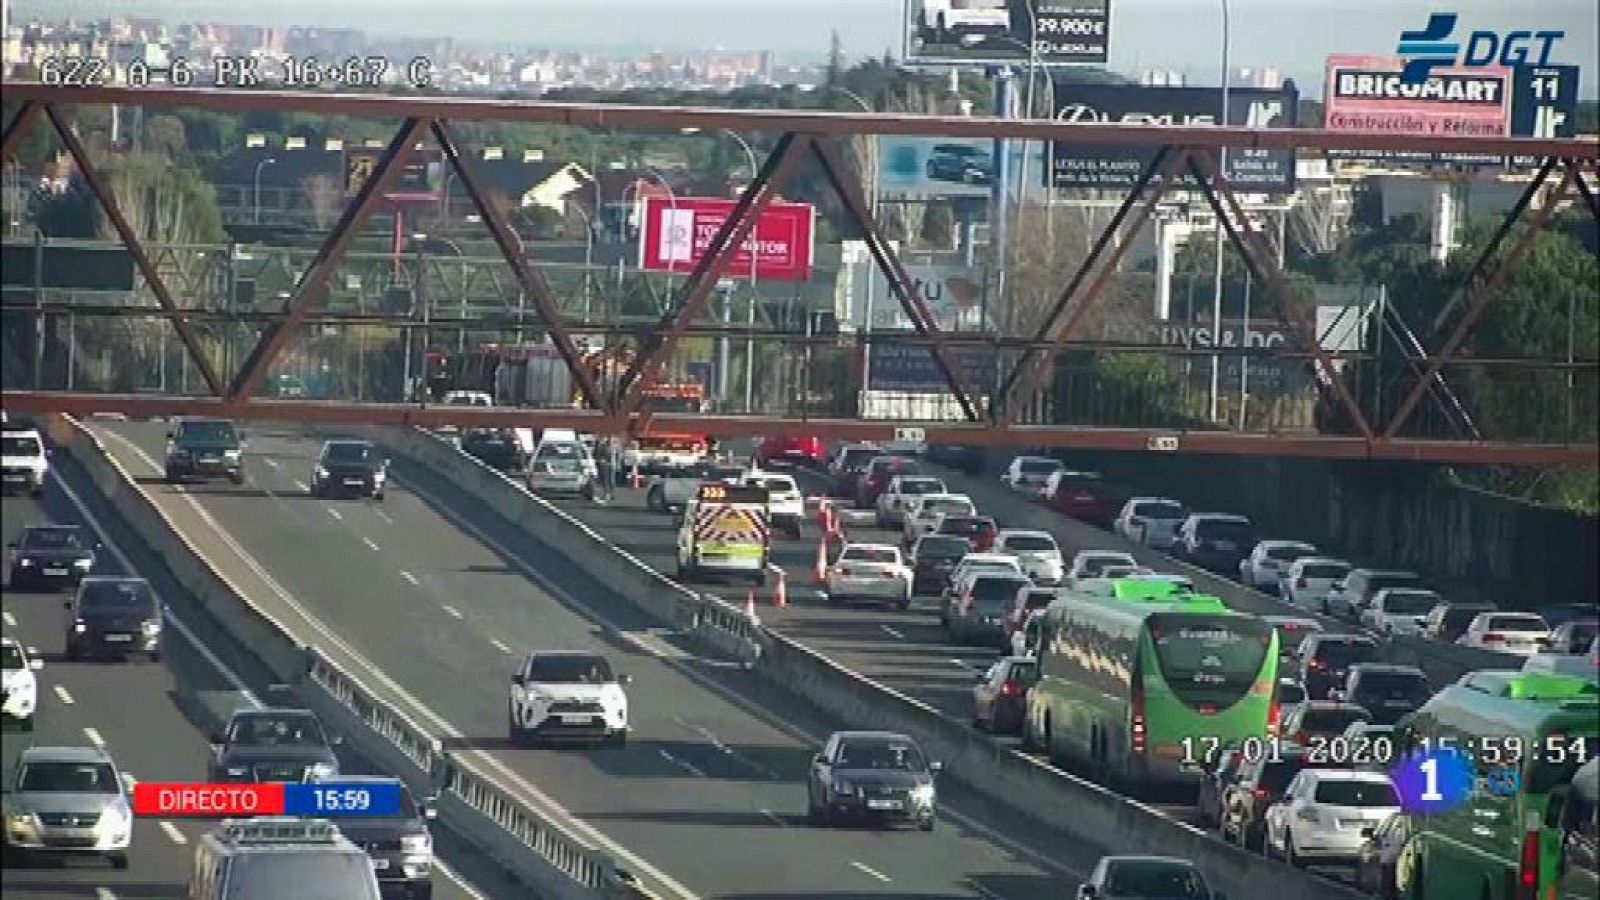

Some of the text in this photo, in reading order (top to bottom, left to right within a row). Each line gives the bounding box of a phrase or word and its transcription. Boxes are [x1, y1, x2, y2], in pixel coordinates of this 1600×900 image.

[1339, 74, 1498, 100] BRICOMART
[1531, 78, 1558, 98] 11
[1330, 111, 1504, 135] Construcción y Reforma
